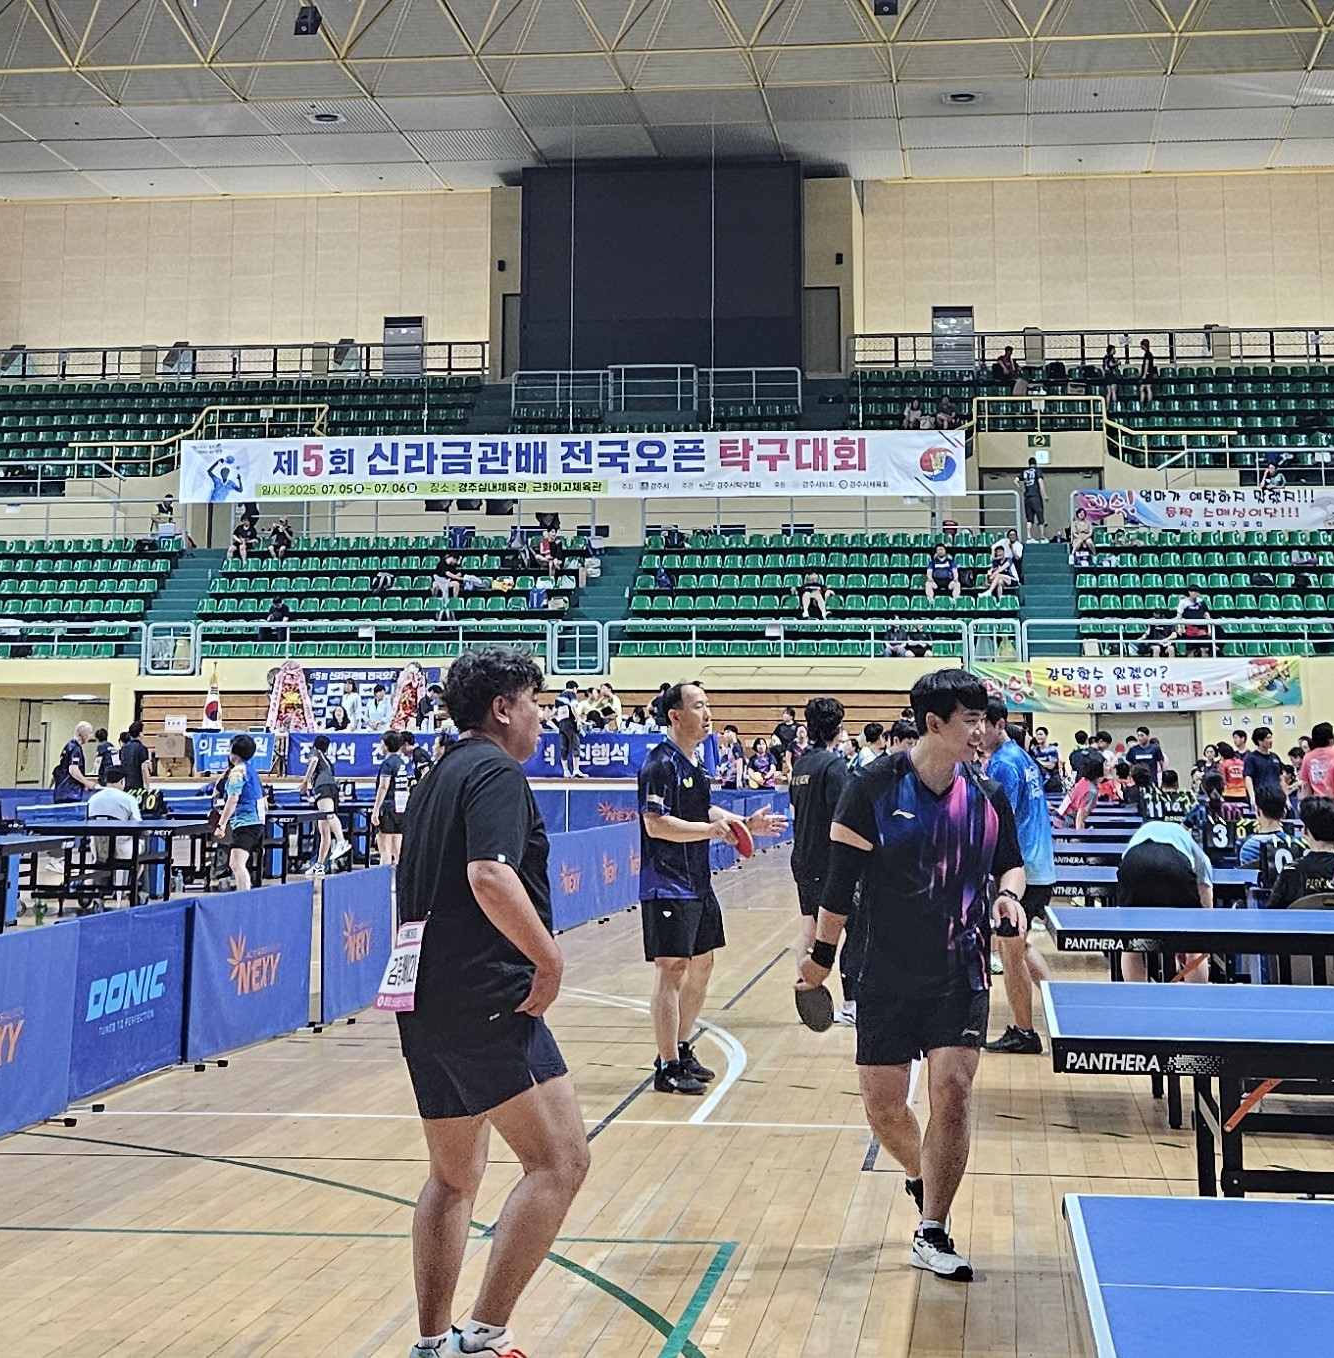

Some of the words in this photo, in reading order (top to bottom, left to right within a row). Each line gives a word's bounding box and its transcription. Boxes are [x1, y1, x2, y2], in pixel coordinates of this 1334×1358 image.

[1035, 435, 1044, 446] 2
[271, 443, 354, 478] 제5회
[367, 441, 547, 476] 신라금관배
[560, 438, 706, 474] 전국오픈
[719, 436, 867, 472] 탁구대회
[261, 484, 281, 496] 일시
[430, 482, 450, 493] 장소
[650, 482, 670, 491] 경주시
[1140, 489, 1181, 503] 엄마가
[1113, 665, 1168, 681] 있겠어?
[1047, 684, 1107, 699] 서라벌의
[1116, 683, 1151, 698] 네트!
[198, 736, 268, 759] 의료원
[1213, 824, 1229, 849] 3
[1053, 856, 1085, 864] ANTHERA
[1052, 886, 1085, 896] NTHERA
[1064, 937, 1125, 951] PANTHERA
[237, 952, 282, 996] NEXY
[85, 959, 168, 1023] DONIC
[1065, 1051, 1161, 1073] PANTHERA
